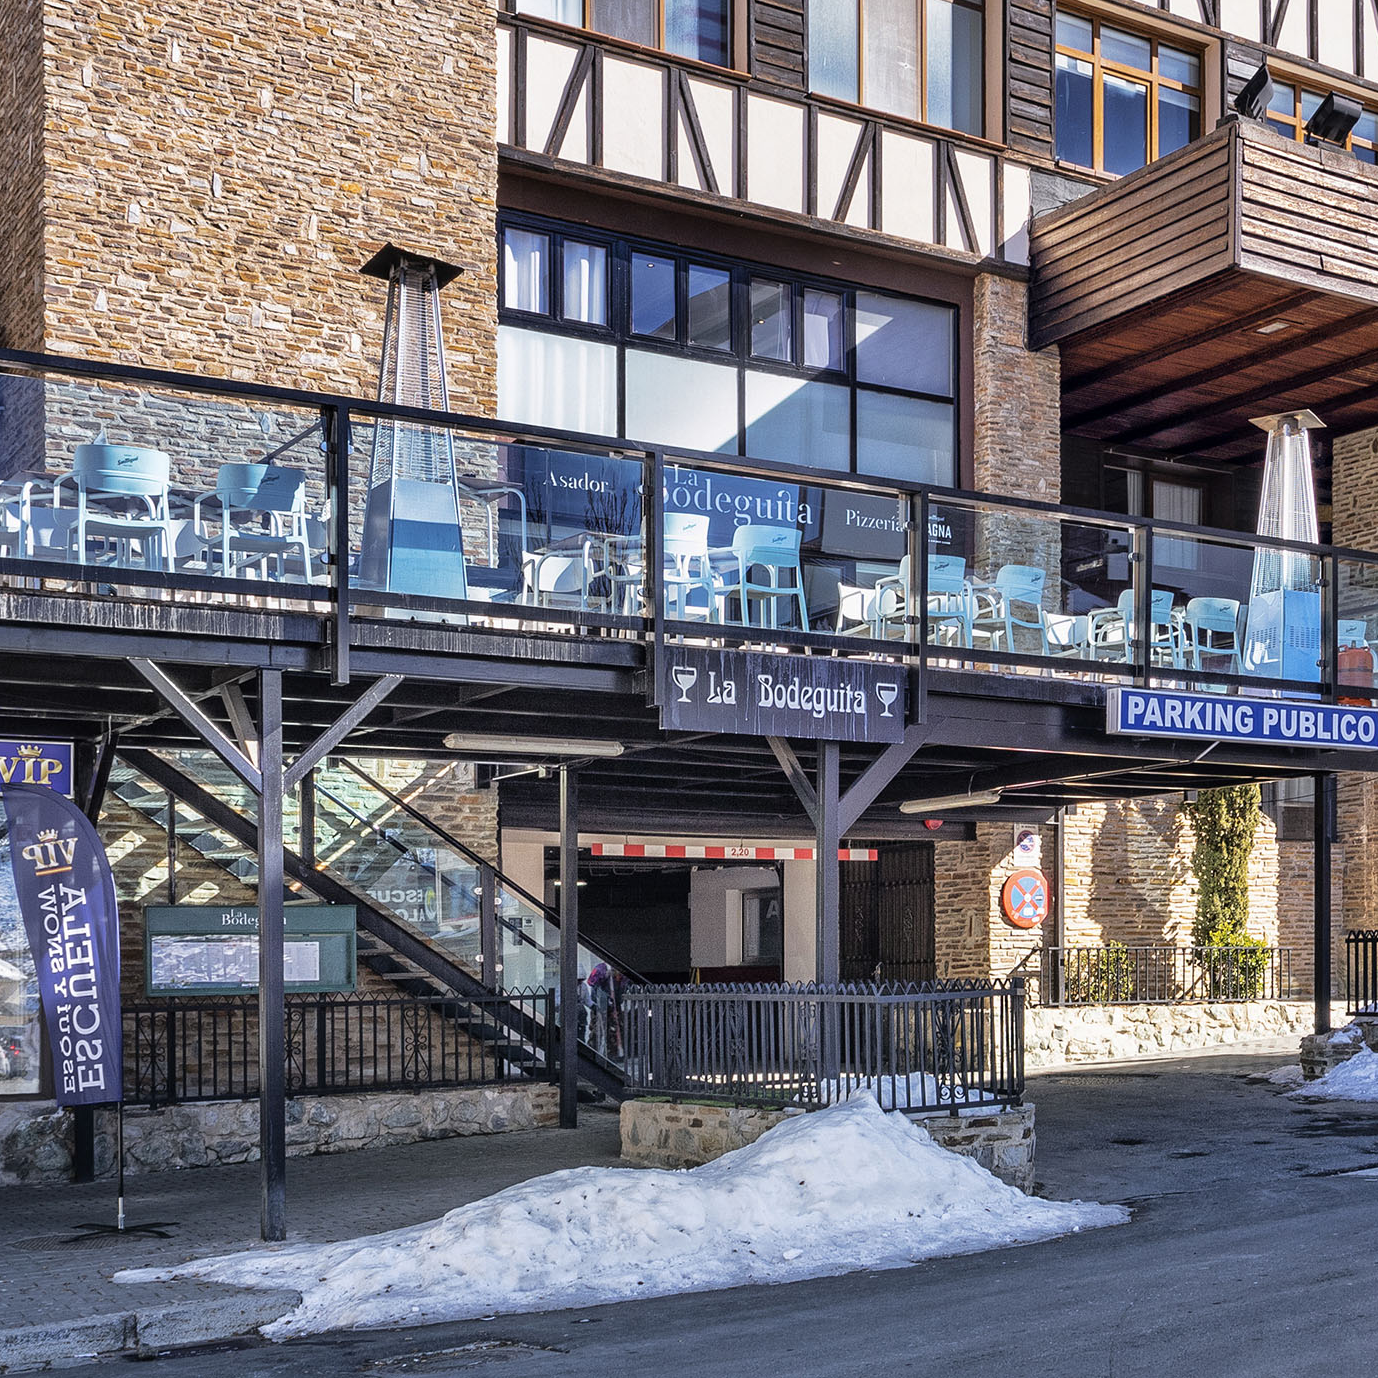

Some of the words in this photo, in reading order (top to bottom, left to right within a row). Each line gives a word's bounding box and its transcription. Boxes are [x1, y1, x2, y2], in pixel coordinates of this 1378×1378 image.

[543, 471, 609, 494] Asador
[674, 464, 698, 487] La
[706, 670, 736, 705] La
[757, 675, 866, 719] Bodeguita
[1127, 695, 1254, 734] PARKING
[1263, 707, 1376, 743] PUBLICO
[730, 847, 750, 857] 2,20
[222, 913, 287, 928] Bodega
[230, 909, 242, 917] La
